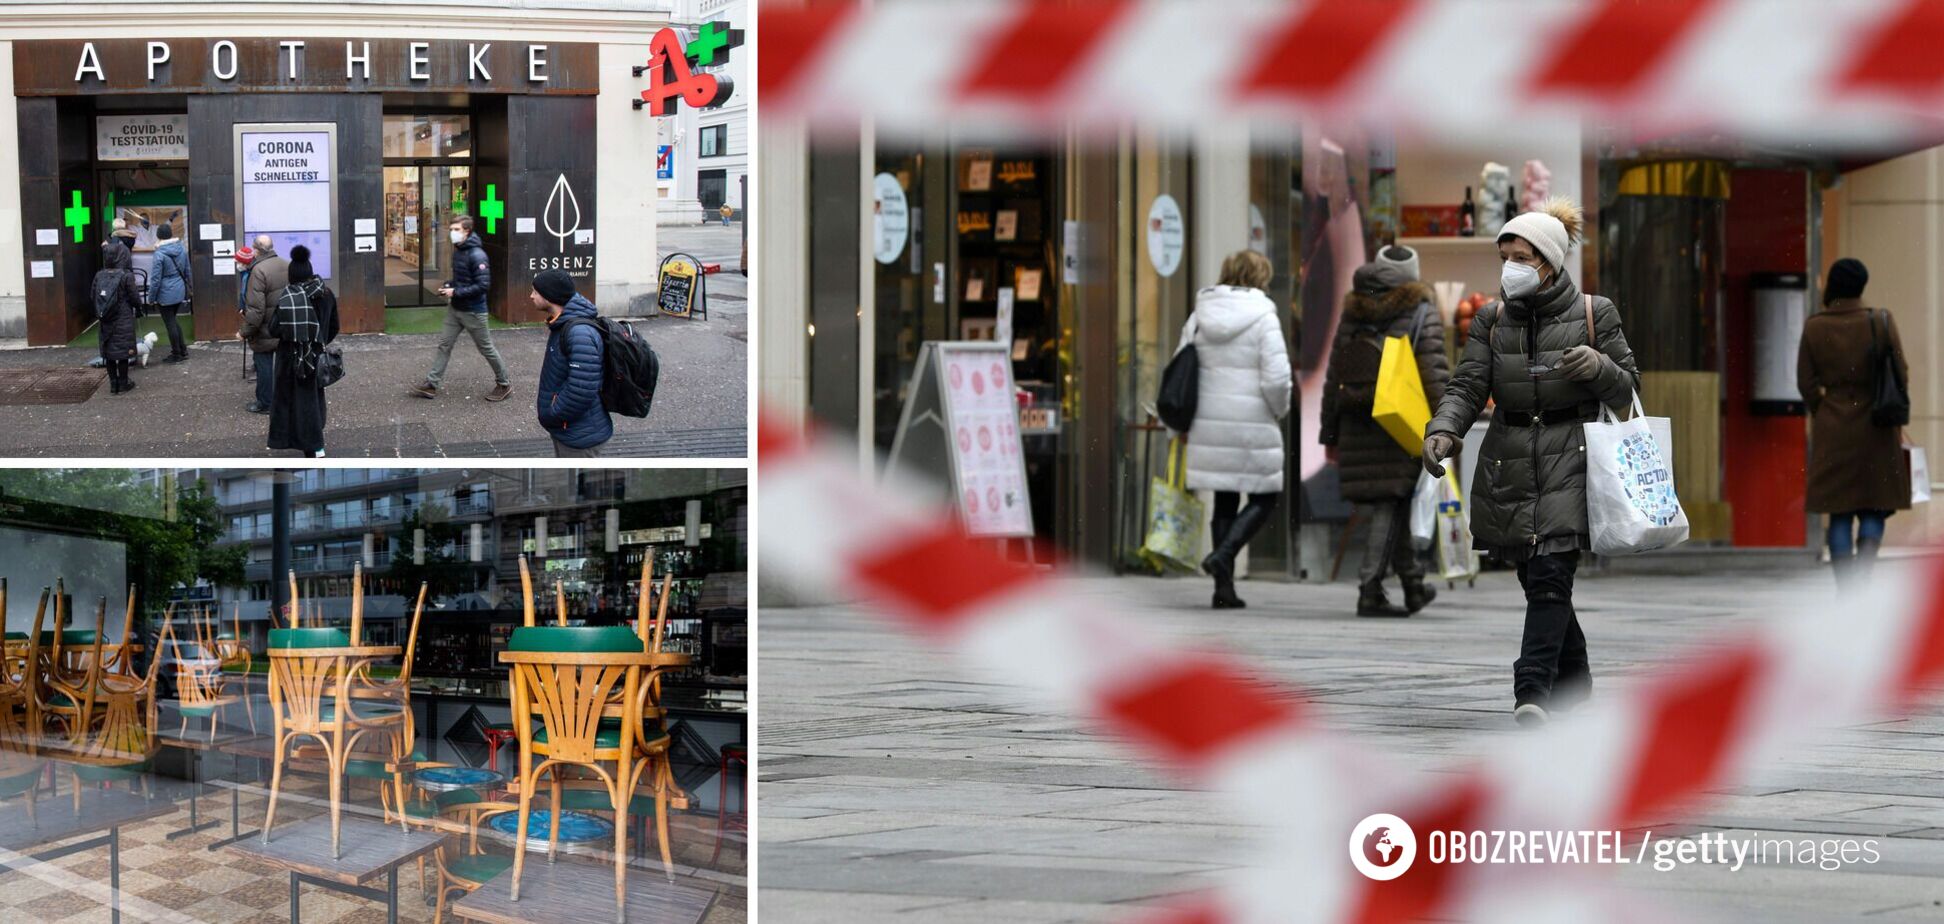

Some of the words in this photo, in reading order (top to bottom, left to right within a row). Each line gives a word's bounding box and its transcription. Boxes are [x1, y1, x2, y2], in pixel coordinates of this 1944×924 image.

[74, 40, 548, 82] APOTHEKE
[122, 124, 173, 135] COVID-19
[110, 135, 184, 147] TESTSTATION
[258, 141, 314, 154] CORONA
[265, 158, 308, 168] ANTIGEN
[254, 171, 319, 181] SCHNELLTEST
[529, 256, 593, 270] ESSENZ
